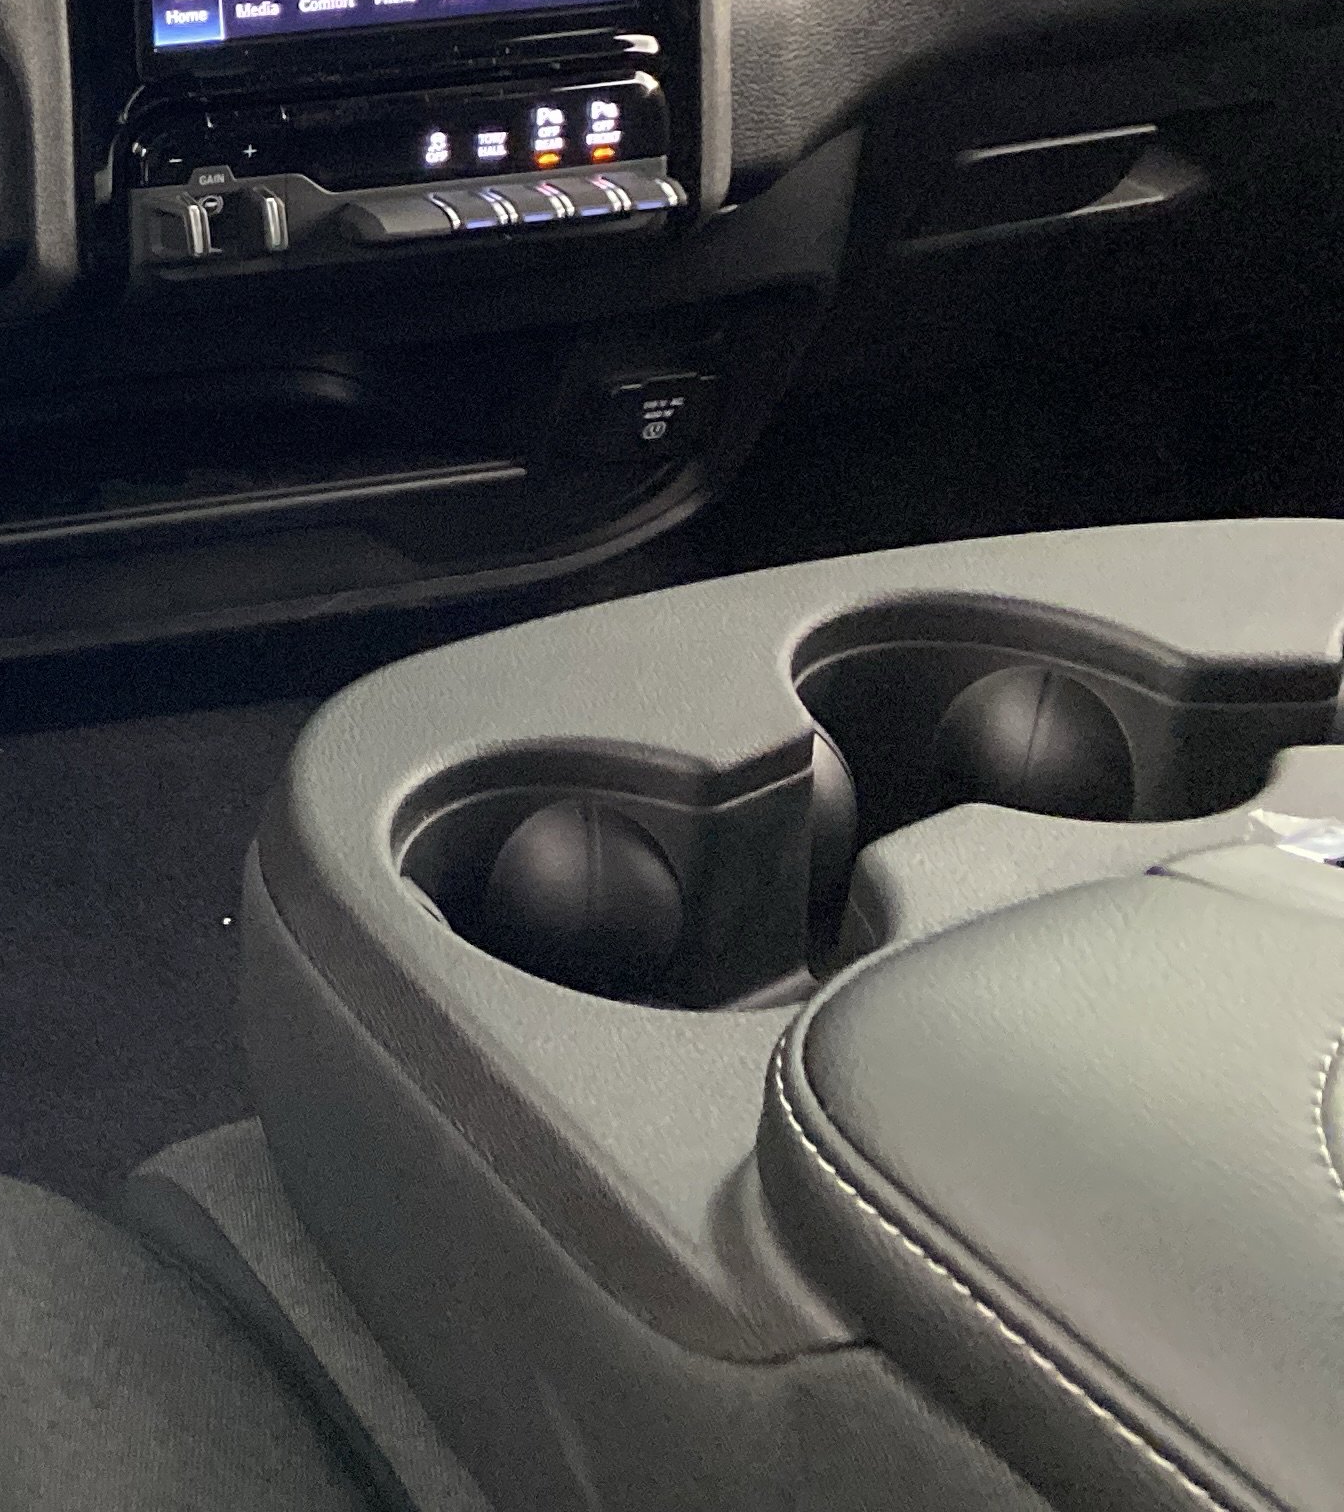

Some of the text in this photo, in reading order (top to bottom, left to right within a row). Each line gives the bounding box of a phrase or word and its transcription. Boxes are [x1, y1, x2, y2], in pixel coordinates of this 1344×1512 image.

[165, 9, 209, 25] Home
[235, 1, 282, 18] Media
[199, 174, 225, 185] GAIN
